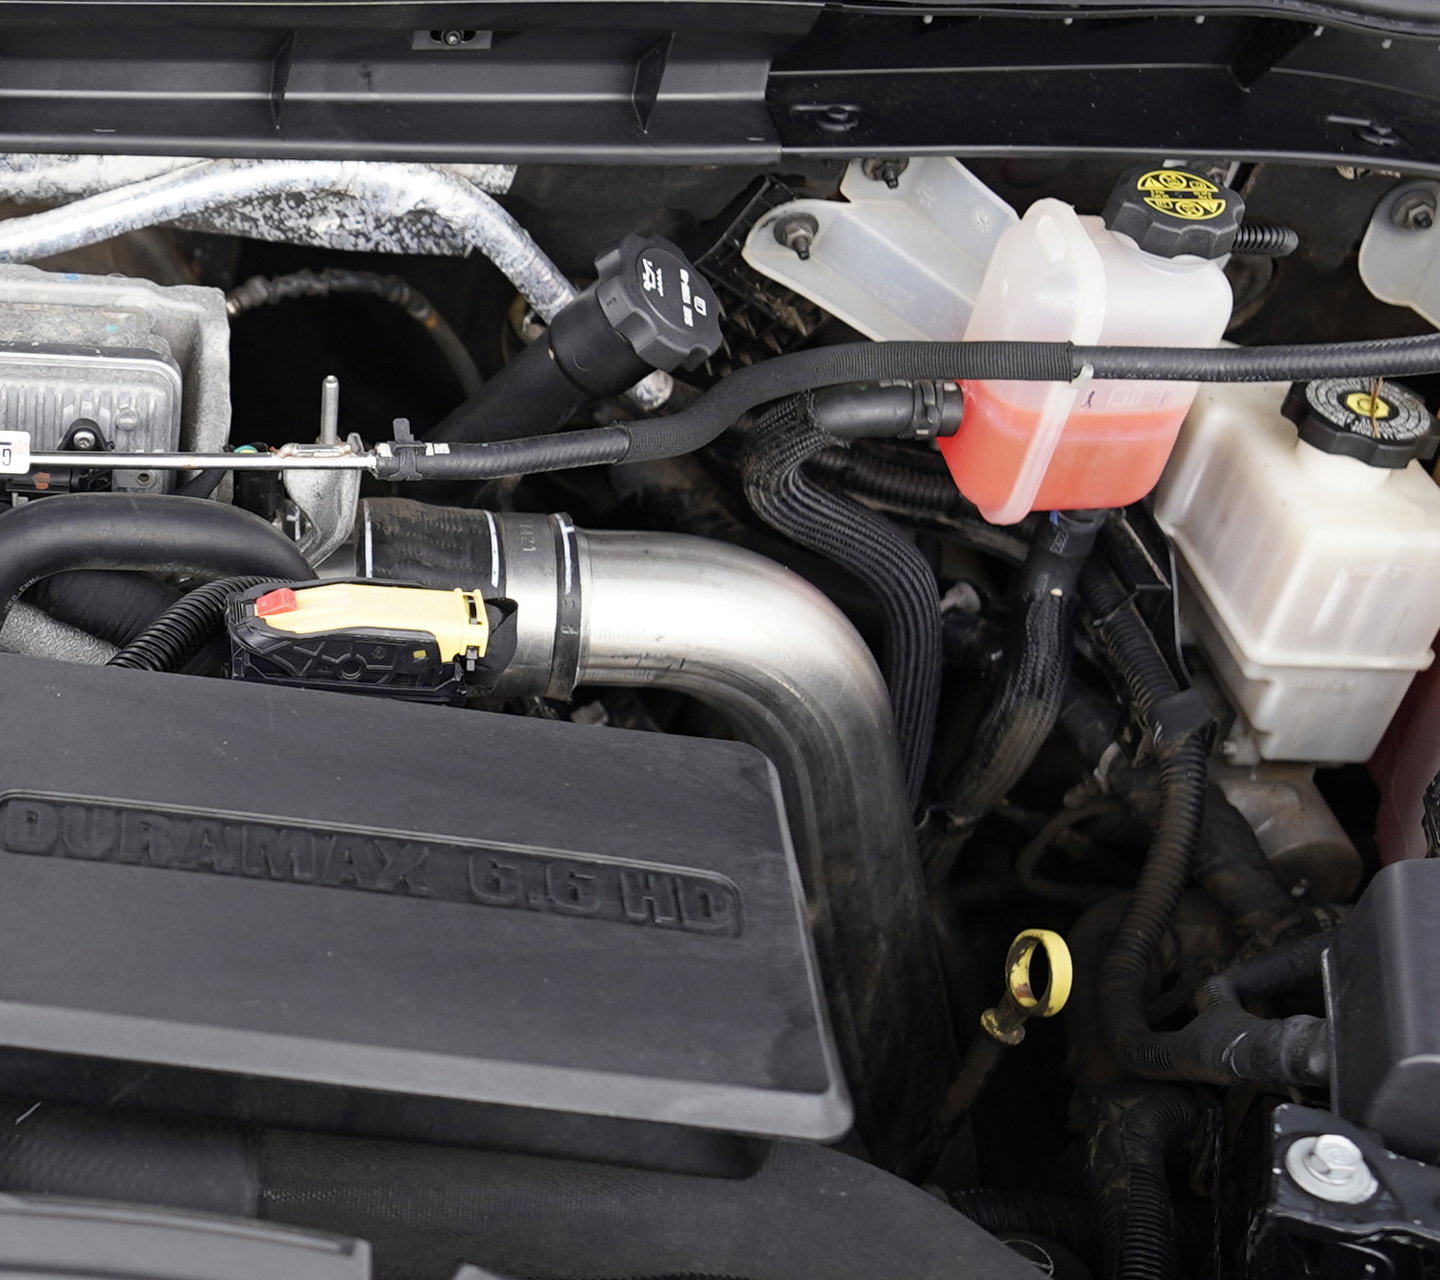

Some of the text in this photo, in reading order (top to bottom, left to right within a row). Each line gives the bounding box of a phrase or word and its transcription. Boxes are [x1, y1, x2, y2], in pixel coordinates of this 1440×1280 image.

[5, 799, 736, 931] DURAMAX 6.6 HD
